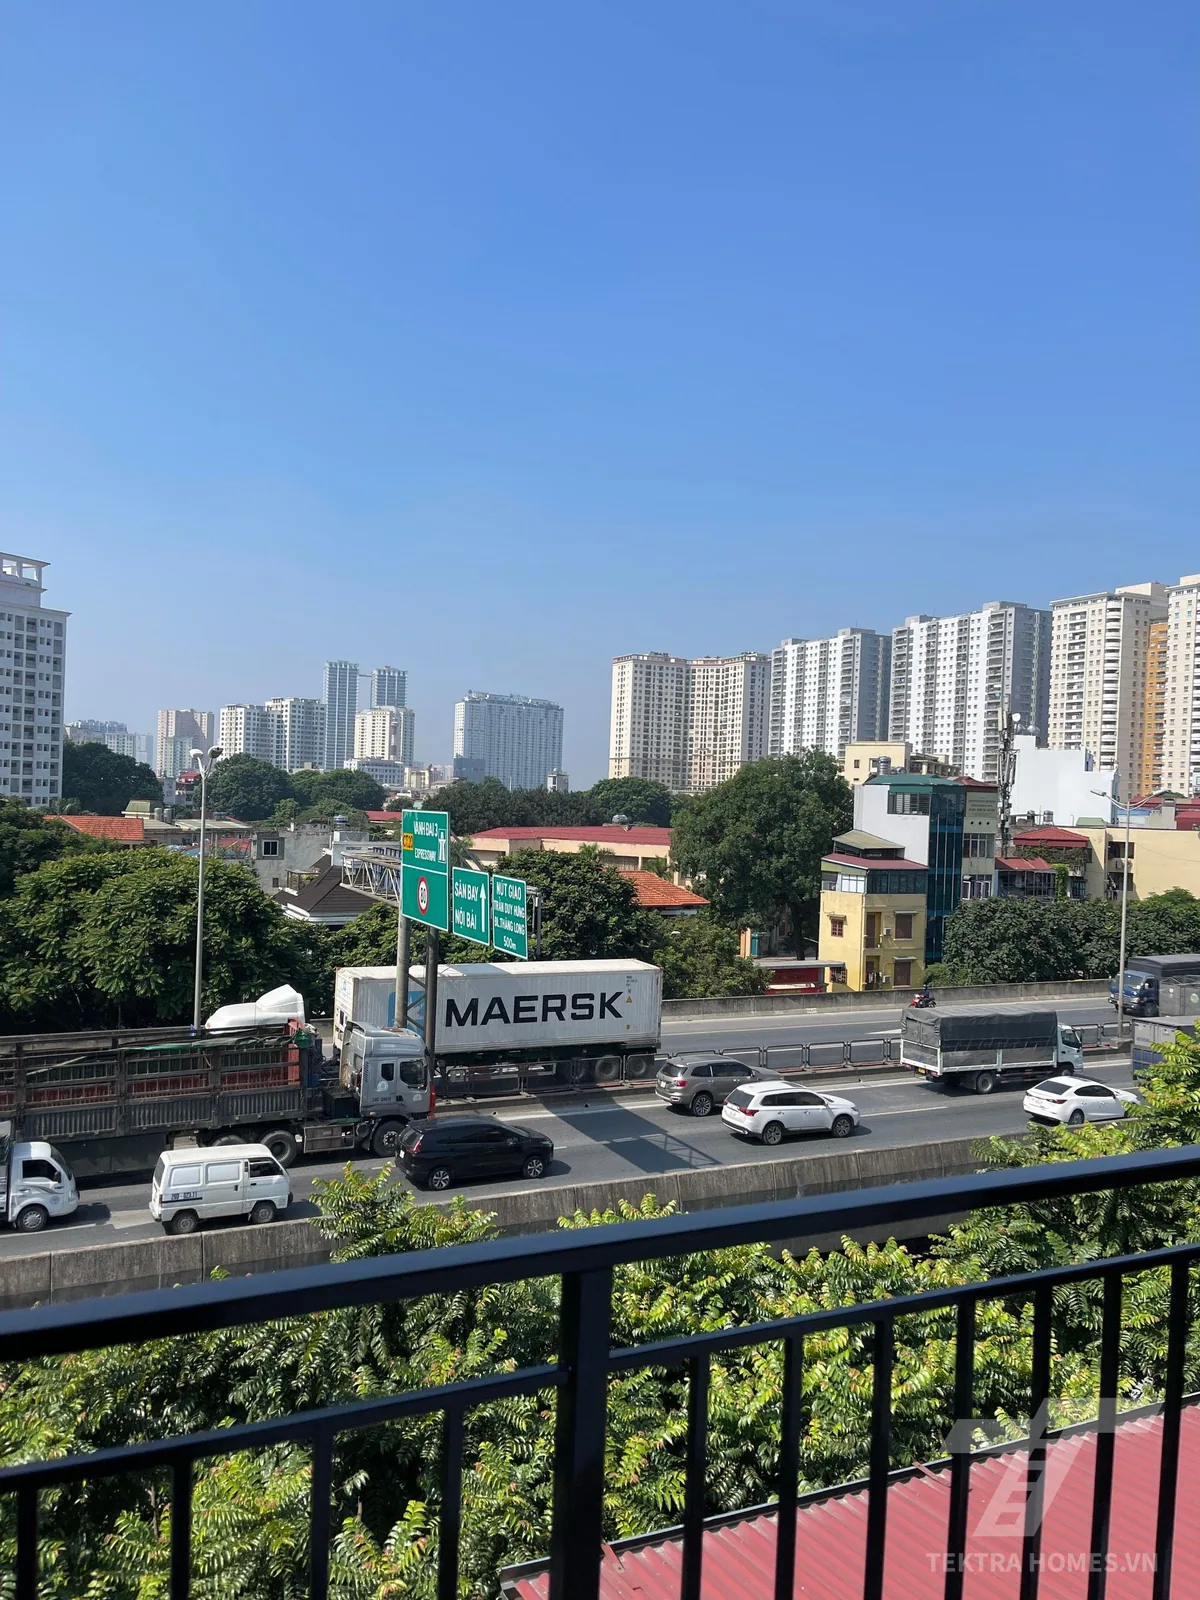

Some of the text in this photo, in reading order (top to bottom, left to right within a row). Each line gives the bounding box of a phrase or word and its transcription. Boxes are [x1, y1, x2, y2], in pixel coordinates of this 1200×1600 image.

[435, 823, 438, 837] 3
[414, 848, 436, 862] EXPRESSWAY
[420, 887, 426, 904] 80
[468, 884, 478, 902] BAY
[496, 880, 522, 900] NÚT GIAO
[504, 902, 513, 915] DUY
[455, 906, 476, 930] NỘI BÀI
[513, 921, 525, 936] LONG
[503, 935, 517, 951] 500m
[445, 991, 624, 1028] MAERSK
